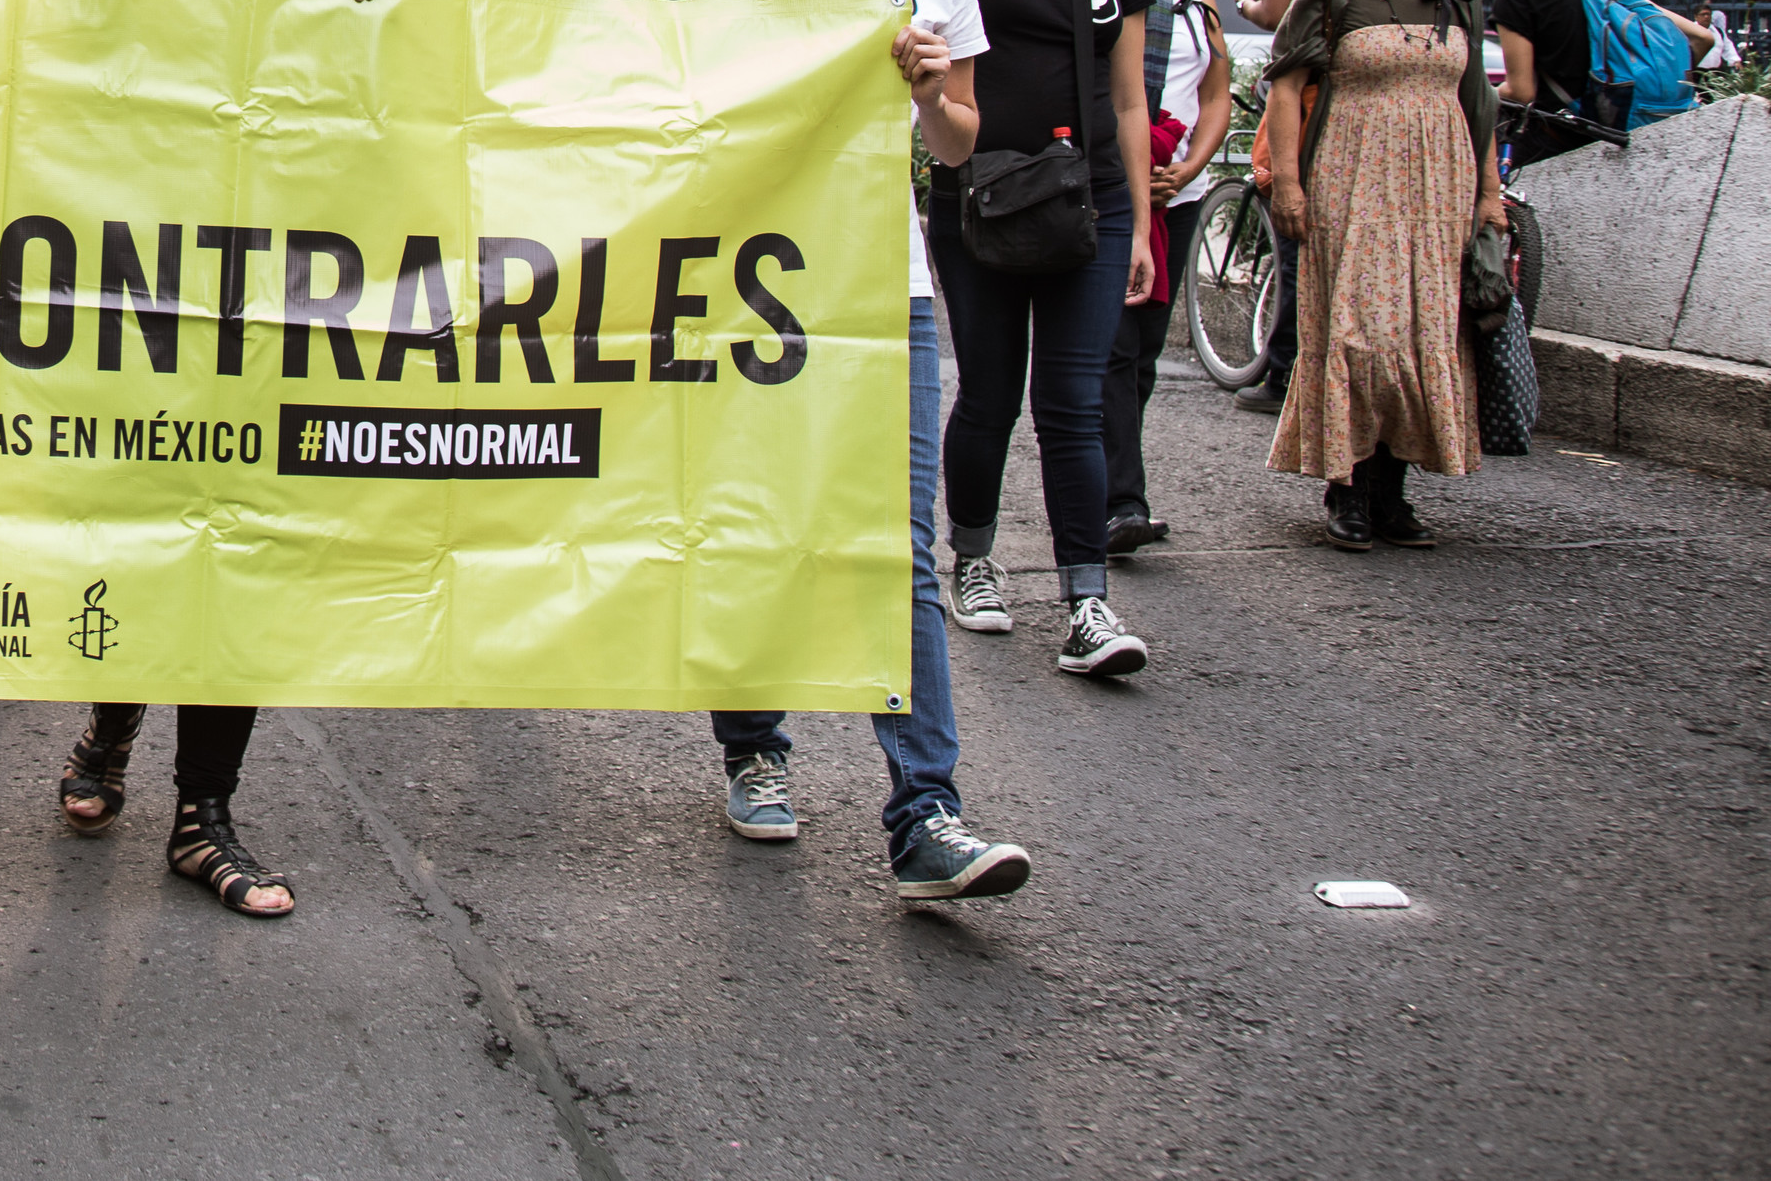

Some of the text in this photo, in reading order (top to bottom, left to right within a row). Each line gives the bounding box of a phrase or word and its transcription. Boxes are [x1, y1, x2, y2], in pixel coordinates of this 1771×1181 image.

[48, 415, 98, 459] EN
[113, 410, 263, 464] MÉXICO
[298, 419, 581, 466] #NOESNORMAL
